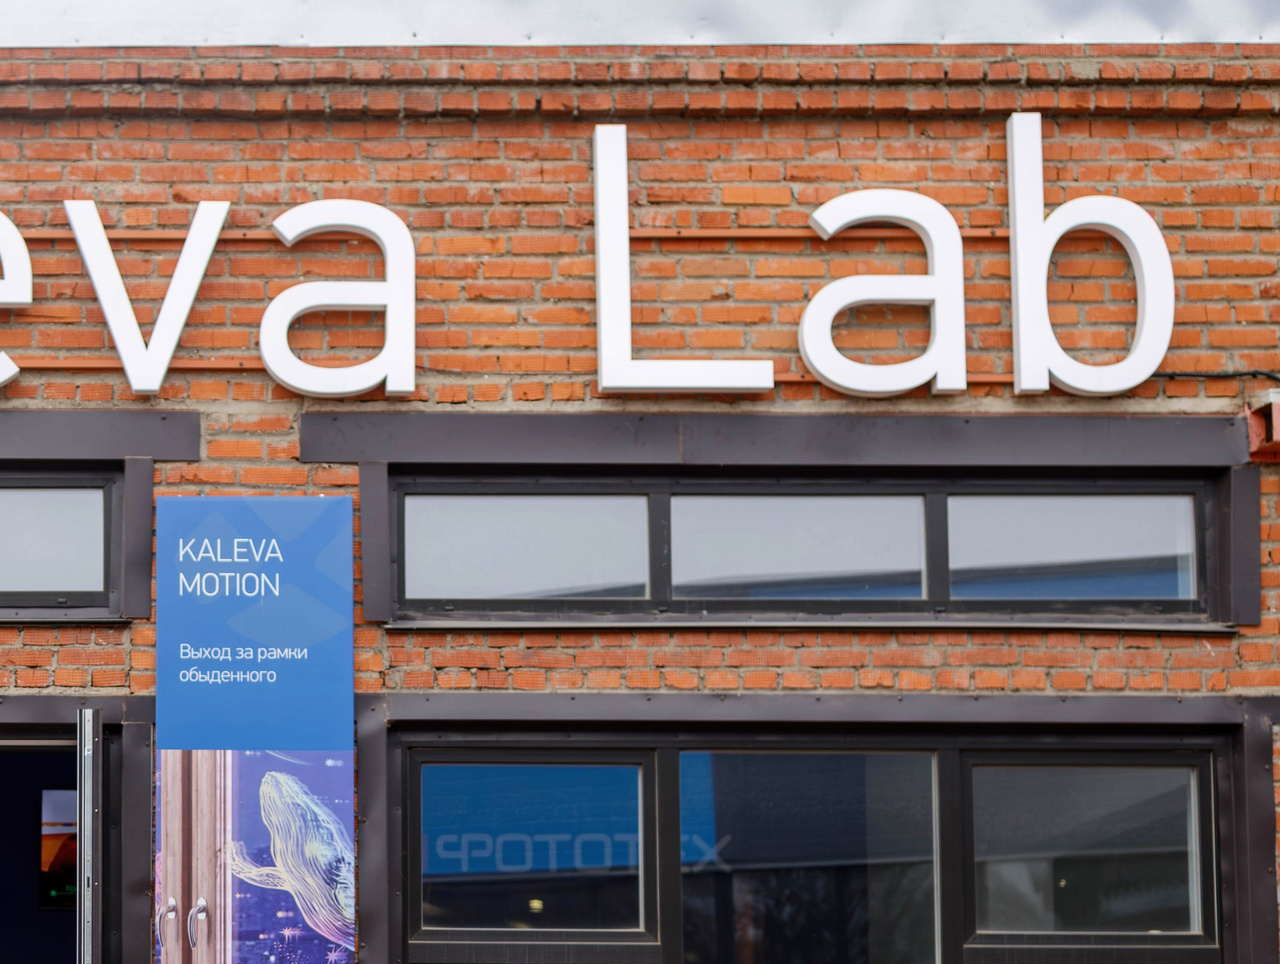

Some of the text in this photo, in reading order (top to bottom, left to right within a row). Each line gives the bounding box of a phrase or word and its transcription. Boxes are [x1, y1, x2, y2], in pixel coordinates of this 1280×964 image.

[593, 112, 1175, 397] Lab
[179, 538, 283, 562] KALEVA
[179, 573, 280, 596] MOTION
[179, 643, 308, 663] Выход за рамки
[179, 666, 277, 684] обыденного
